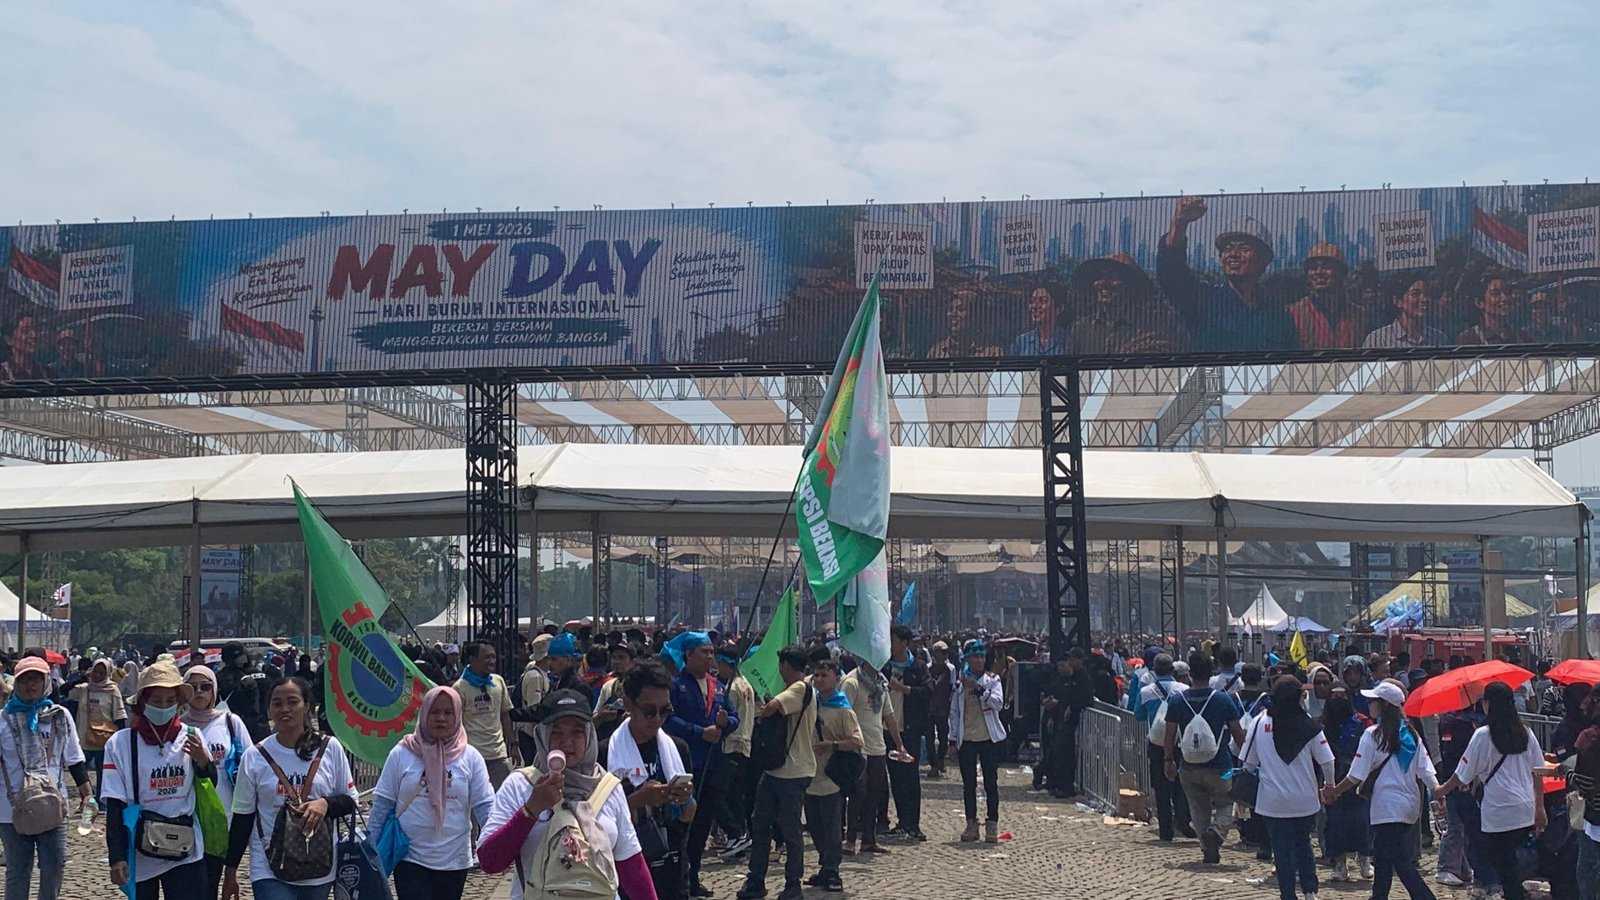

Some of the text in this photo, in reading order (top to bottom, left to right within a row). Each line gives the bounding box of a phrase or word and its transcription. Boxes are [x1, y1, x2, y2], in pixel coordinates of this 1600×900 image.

[1379, 217, 1427, 232] DILINDUNGI
[1537, 214, 1593, 229] KERINGATMU
[453, 222, 533, 237] 1 MEI 2026
[896, 230, 924, 242] LAYAK
[1536, 227, 1596, 242] ADALAH BUKTI
[1003, 232, 1037, 244] BERSATU
[1385, 233, 1424, 246] DIHARGAI
[891, 245, 926, 255] PANTAS
[1006, 244, 1038, 256] NEGARA
[1553, 241, 1580, 252] NYATA
[673, 250, 717, 265] Keadilan
[1386, 247, 1427, 261] DIDENGAR
[1539, 252, 1595, 266] PERJUANGAN
[238, 256, 305, 276] Menyongsong
[326, 237, 664, 301] MAY DAY
[670, 262, 745, 280] Seluruh Pekerja
[68, 268, 101, 281] ADALAH
[248, 271, 296, 288] Era Baru
[83, 279, 109, 289] NYATA
[685, 277, 732, 291] Indonesia
[69, 290, 123, 304] PERJUANGAN
[232, 284, 313, 304] Ketenagakerjaan
[383, 300, 620, 318] HARI BURUH INTERNASIONAL
[432, 320, 553, 334] BEKERJA BERSAMA
[382, 332, 608, 348] MENGGERAKKAN EKONOMI BANGSA
[810, 519, 841, 581] BEKASI
[202, 557, 222, 566] MAY
[330, 618, 398, 690] KORWIL BARAT
[347, 690, 379, 719] BEKASI
[157, 786, 178, 795] 2026
